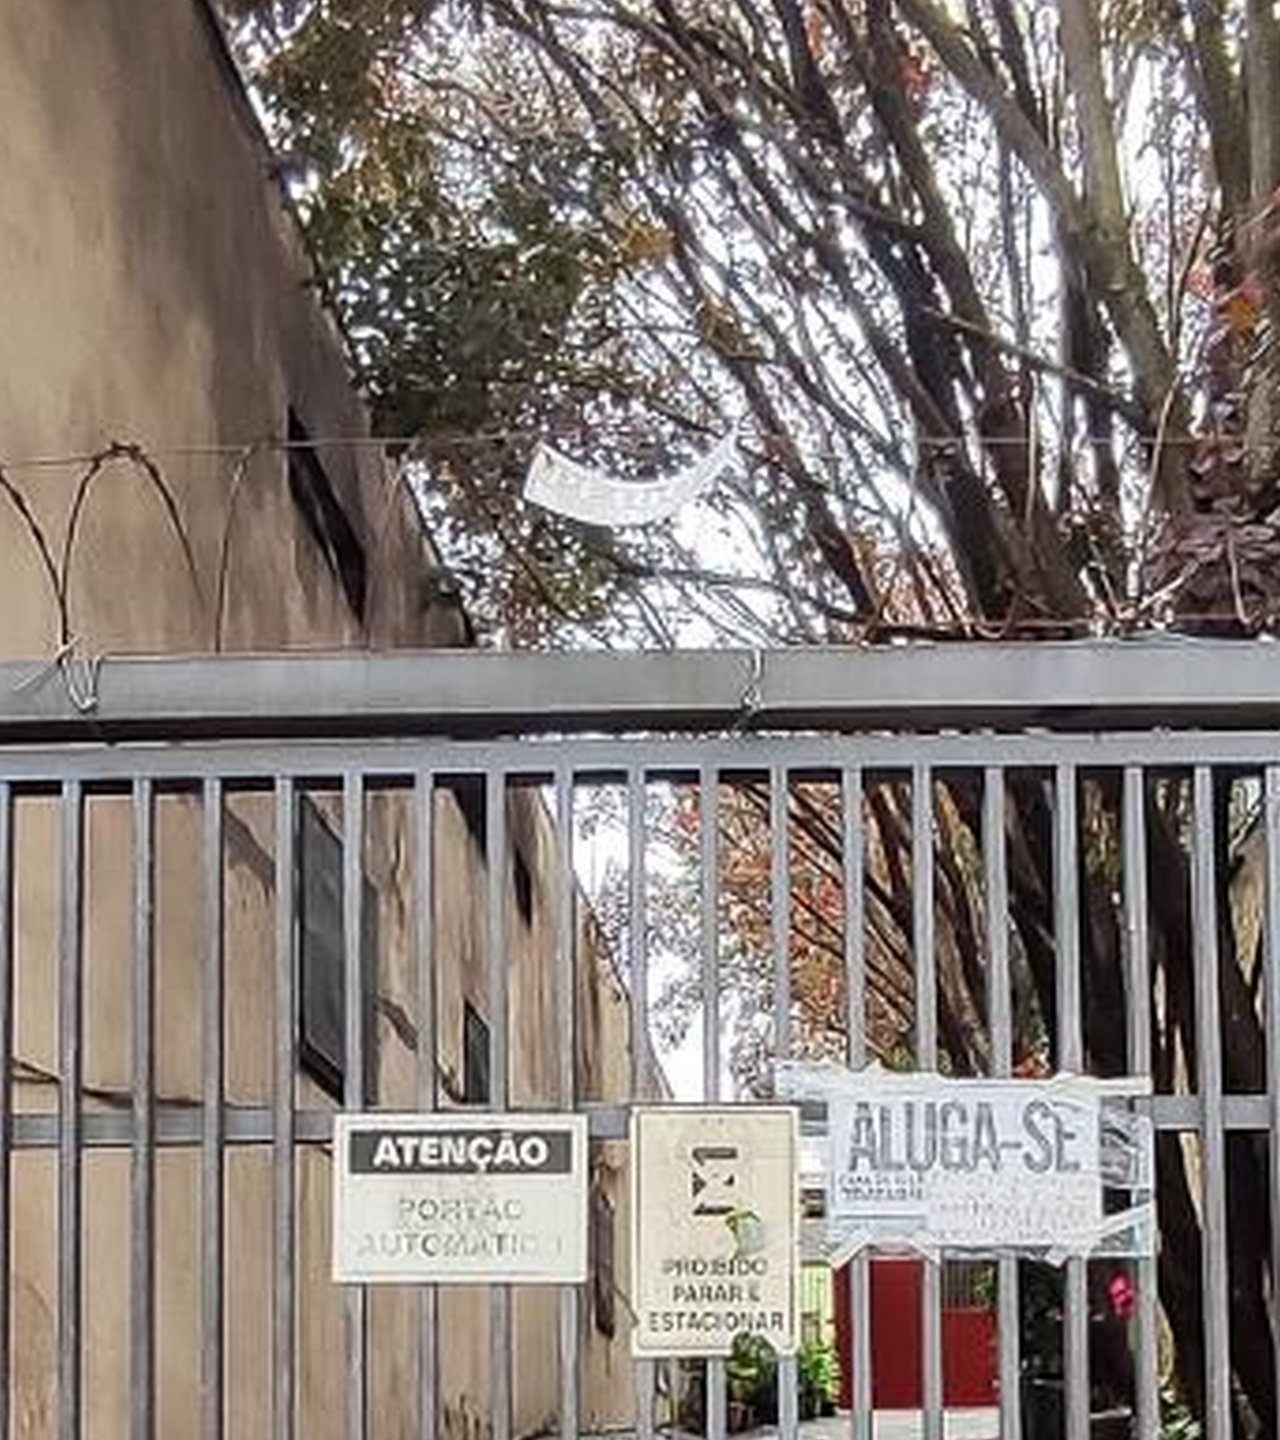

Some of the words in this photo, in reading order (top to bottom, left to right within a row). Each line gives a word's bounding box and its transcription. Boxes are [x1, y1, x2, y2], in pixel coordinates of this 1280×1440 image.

[848, 1098, 1080, 1173] ALUGA-SE
[373, 1134, 549, 1171] ATENÇÃO
[662, 1257, 768, 1276] PROIBIDO
[673, 1285, 742, 1302] PARAR
[649, 1312, 784, 1332] ESTACIONAR
